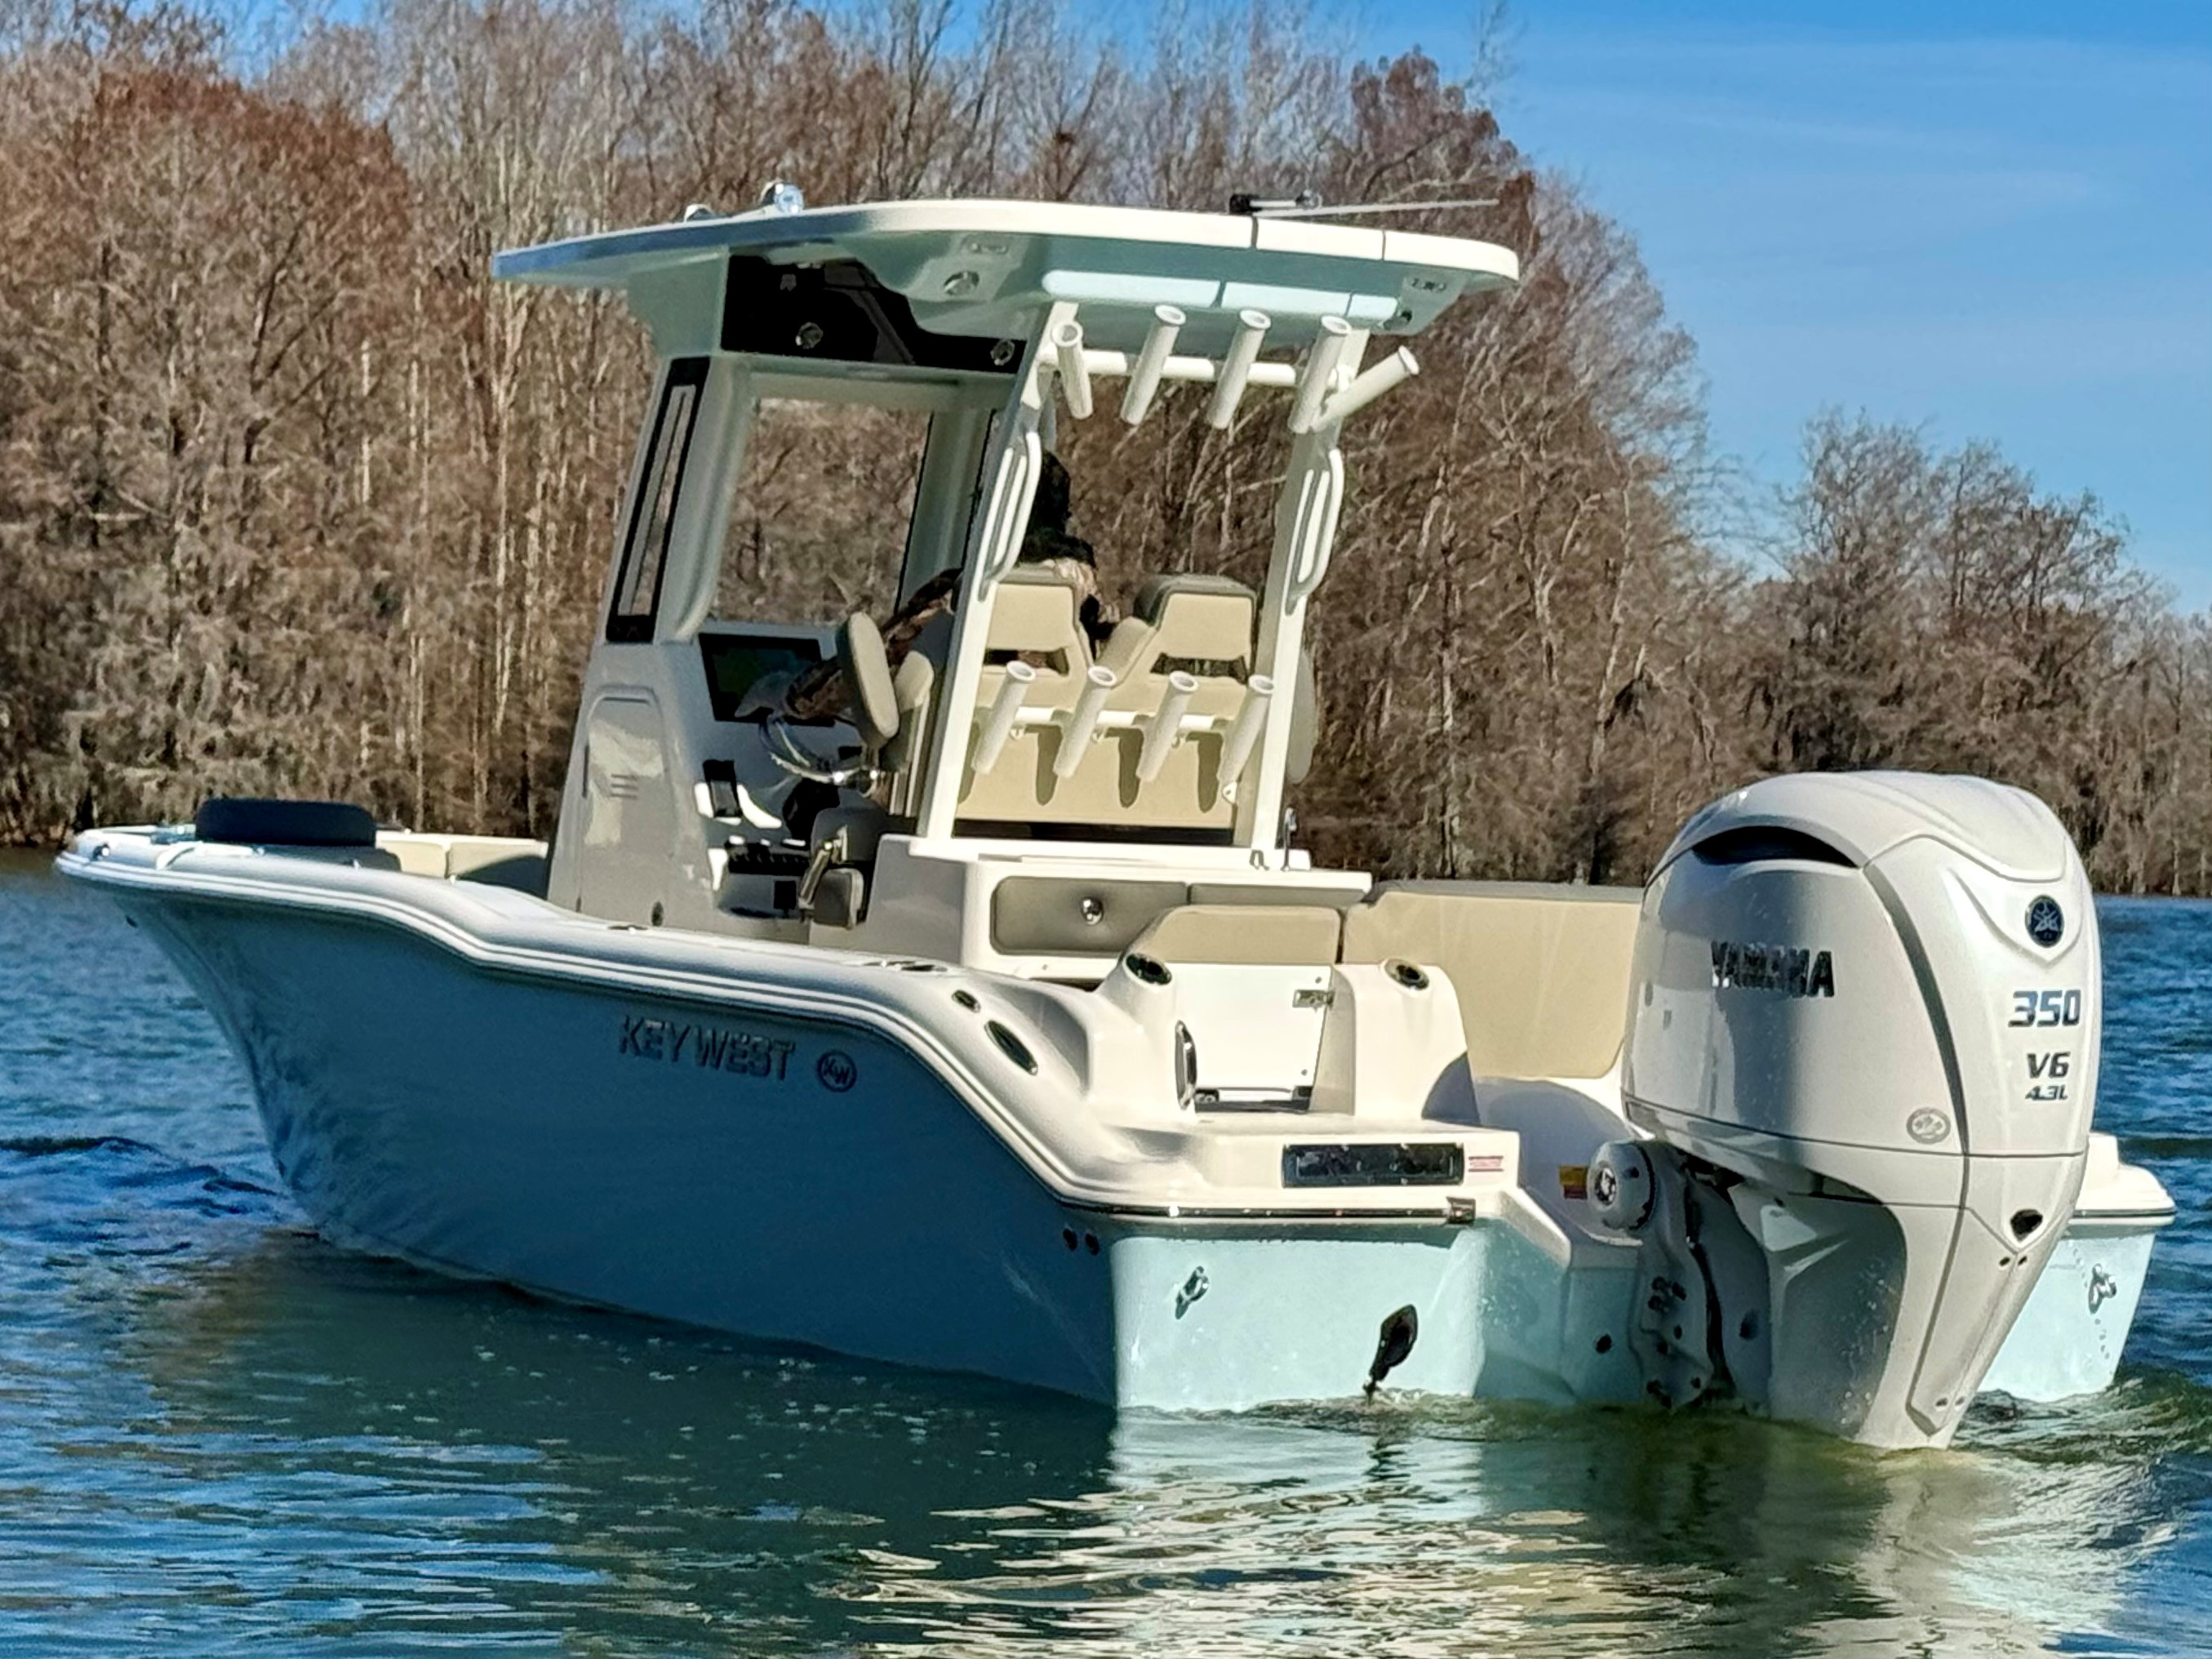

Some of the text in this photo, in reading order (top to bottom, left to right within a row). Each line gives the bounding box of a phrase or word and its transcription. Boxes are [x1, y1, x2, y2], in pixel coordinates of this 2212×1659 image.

[2007, 990, 2081, 1028] 350
[619, 1015, 690, 1062] KEY
[2026, 1052, 2072, 1079] V6
